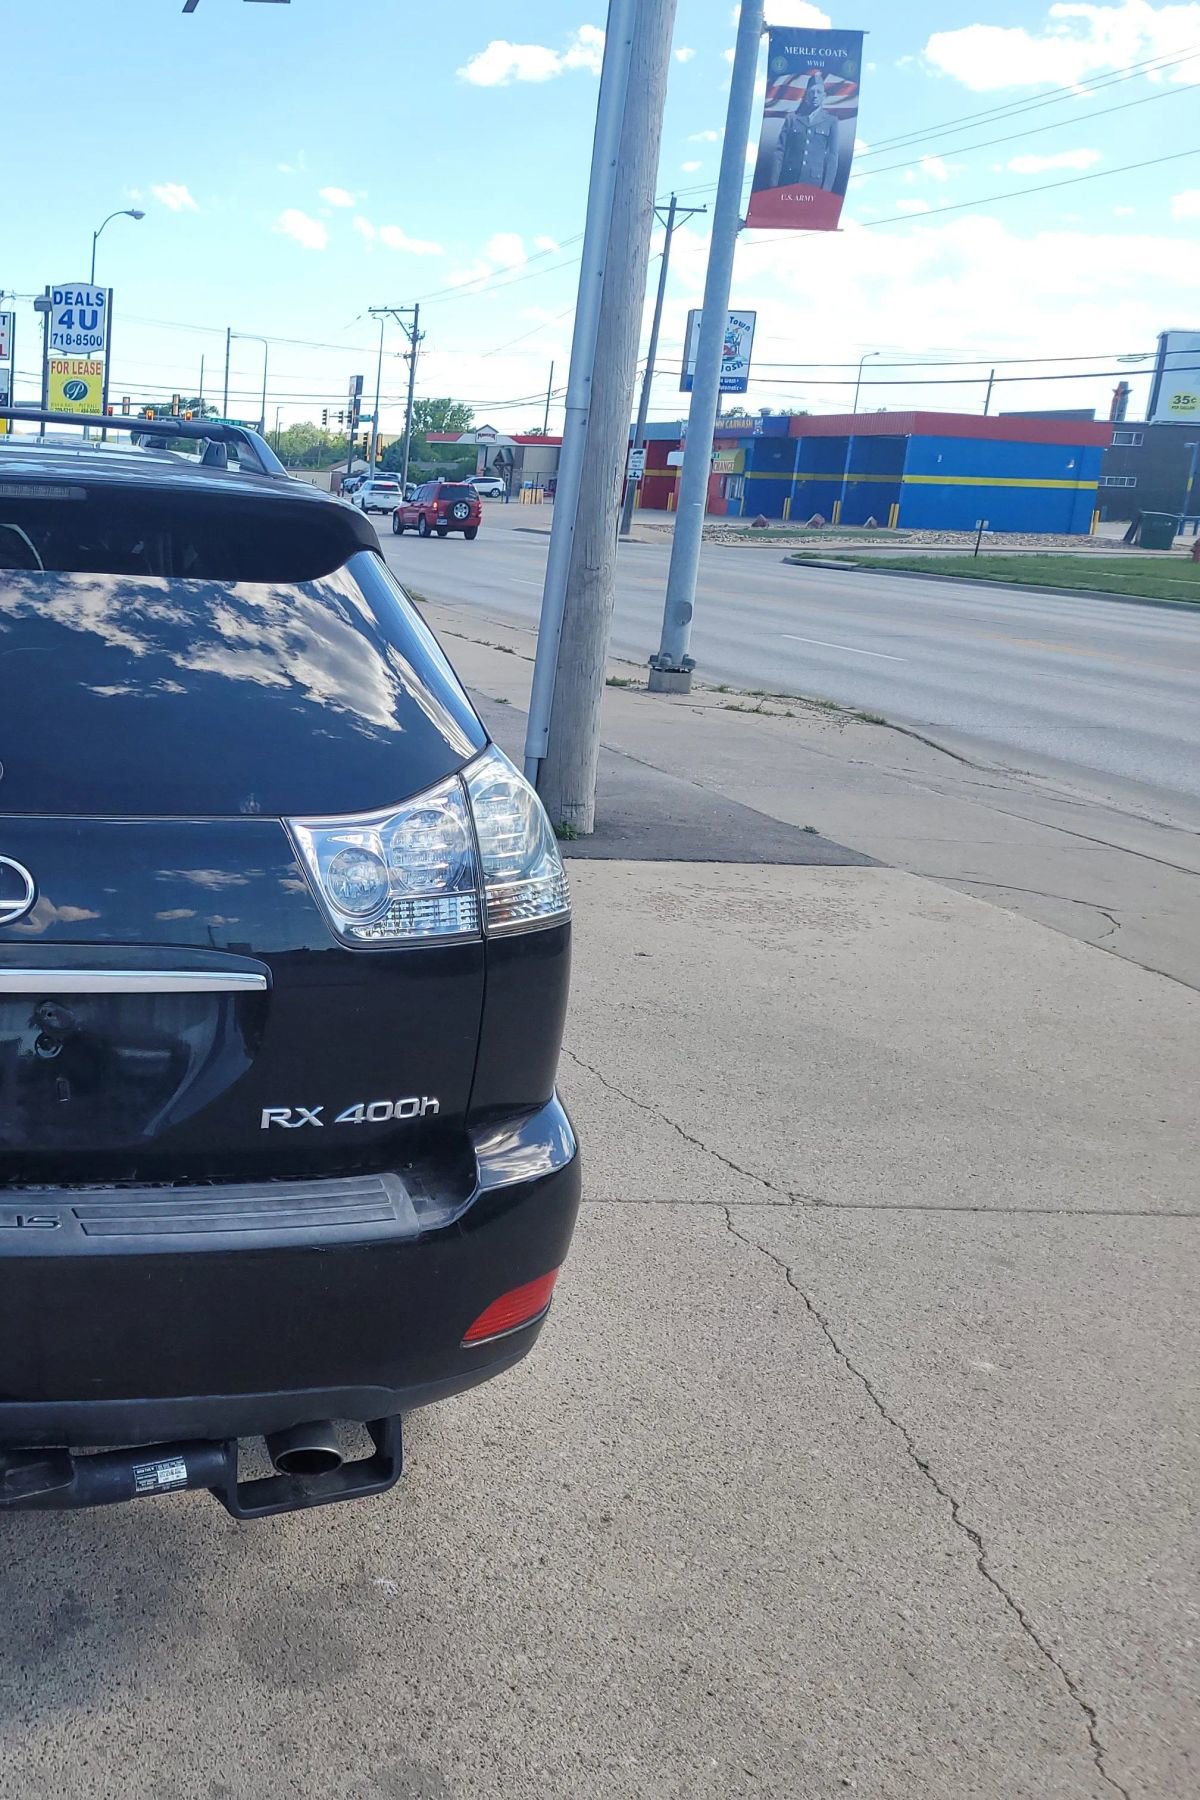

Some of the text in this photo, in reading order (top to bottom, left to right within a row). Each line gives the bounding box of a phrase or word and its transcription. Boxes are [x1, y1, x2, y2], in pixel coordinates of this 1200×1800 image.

[784, 46, 848, 57] MERLE COATS
[793, 194, 814, 202] ARMY
[53, 291, 104, 307] DEALS
[51, 361, 101, 375] FOR LEASE
[261, 1097, 440, 1129] RX 400h
